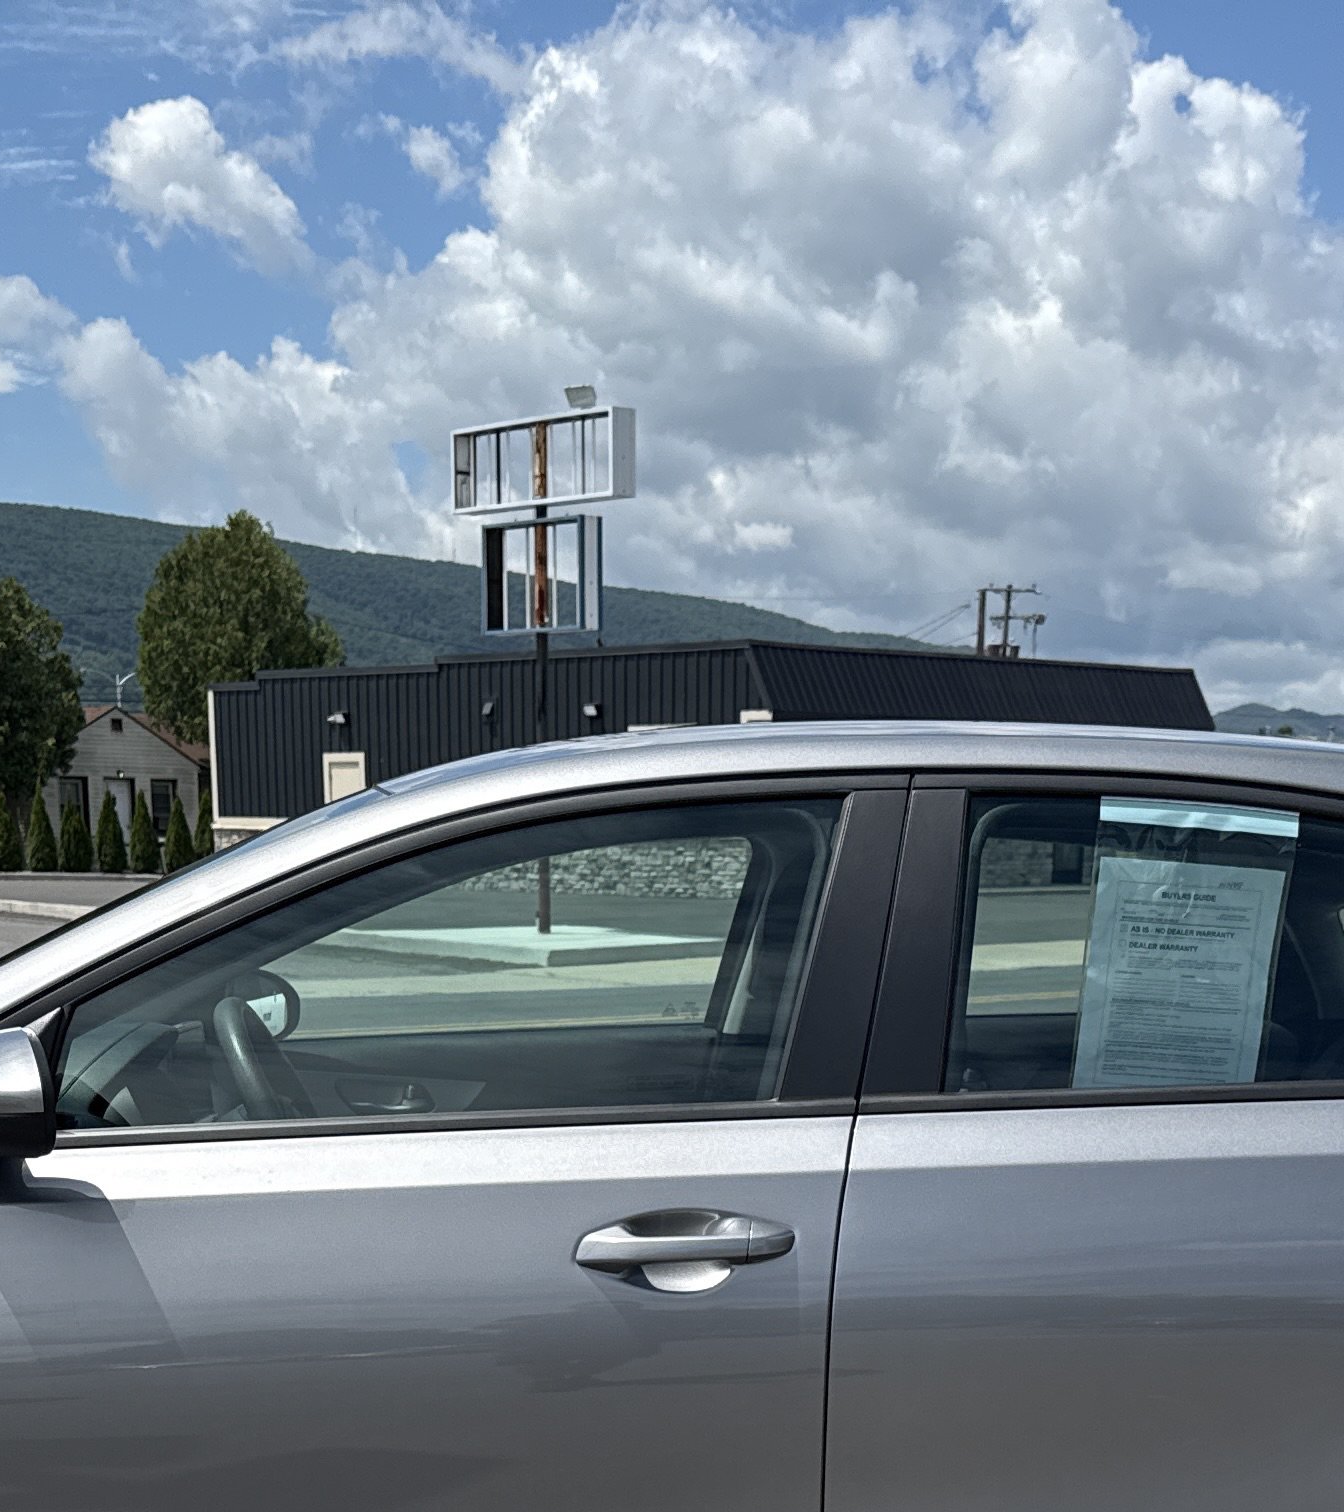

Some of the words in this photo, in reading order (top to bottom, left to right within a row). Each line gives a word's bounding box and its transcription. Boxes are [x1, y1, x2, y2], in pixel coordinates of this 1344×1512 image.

[1194, 893, 1216, 902] GUIDE
[1166, 928, 1194, 937] DEALER
[1196, 930, 1235, 939] WARRANTY
[1129, 941, 1158, 950] DEALER
[1159, 943, 1198, 952] WARRANTY
